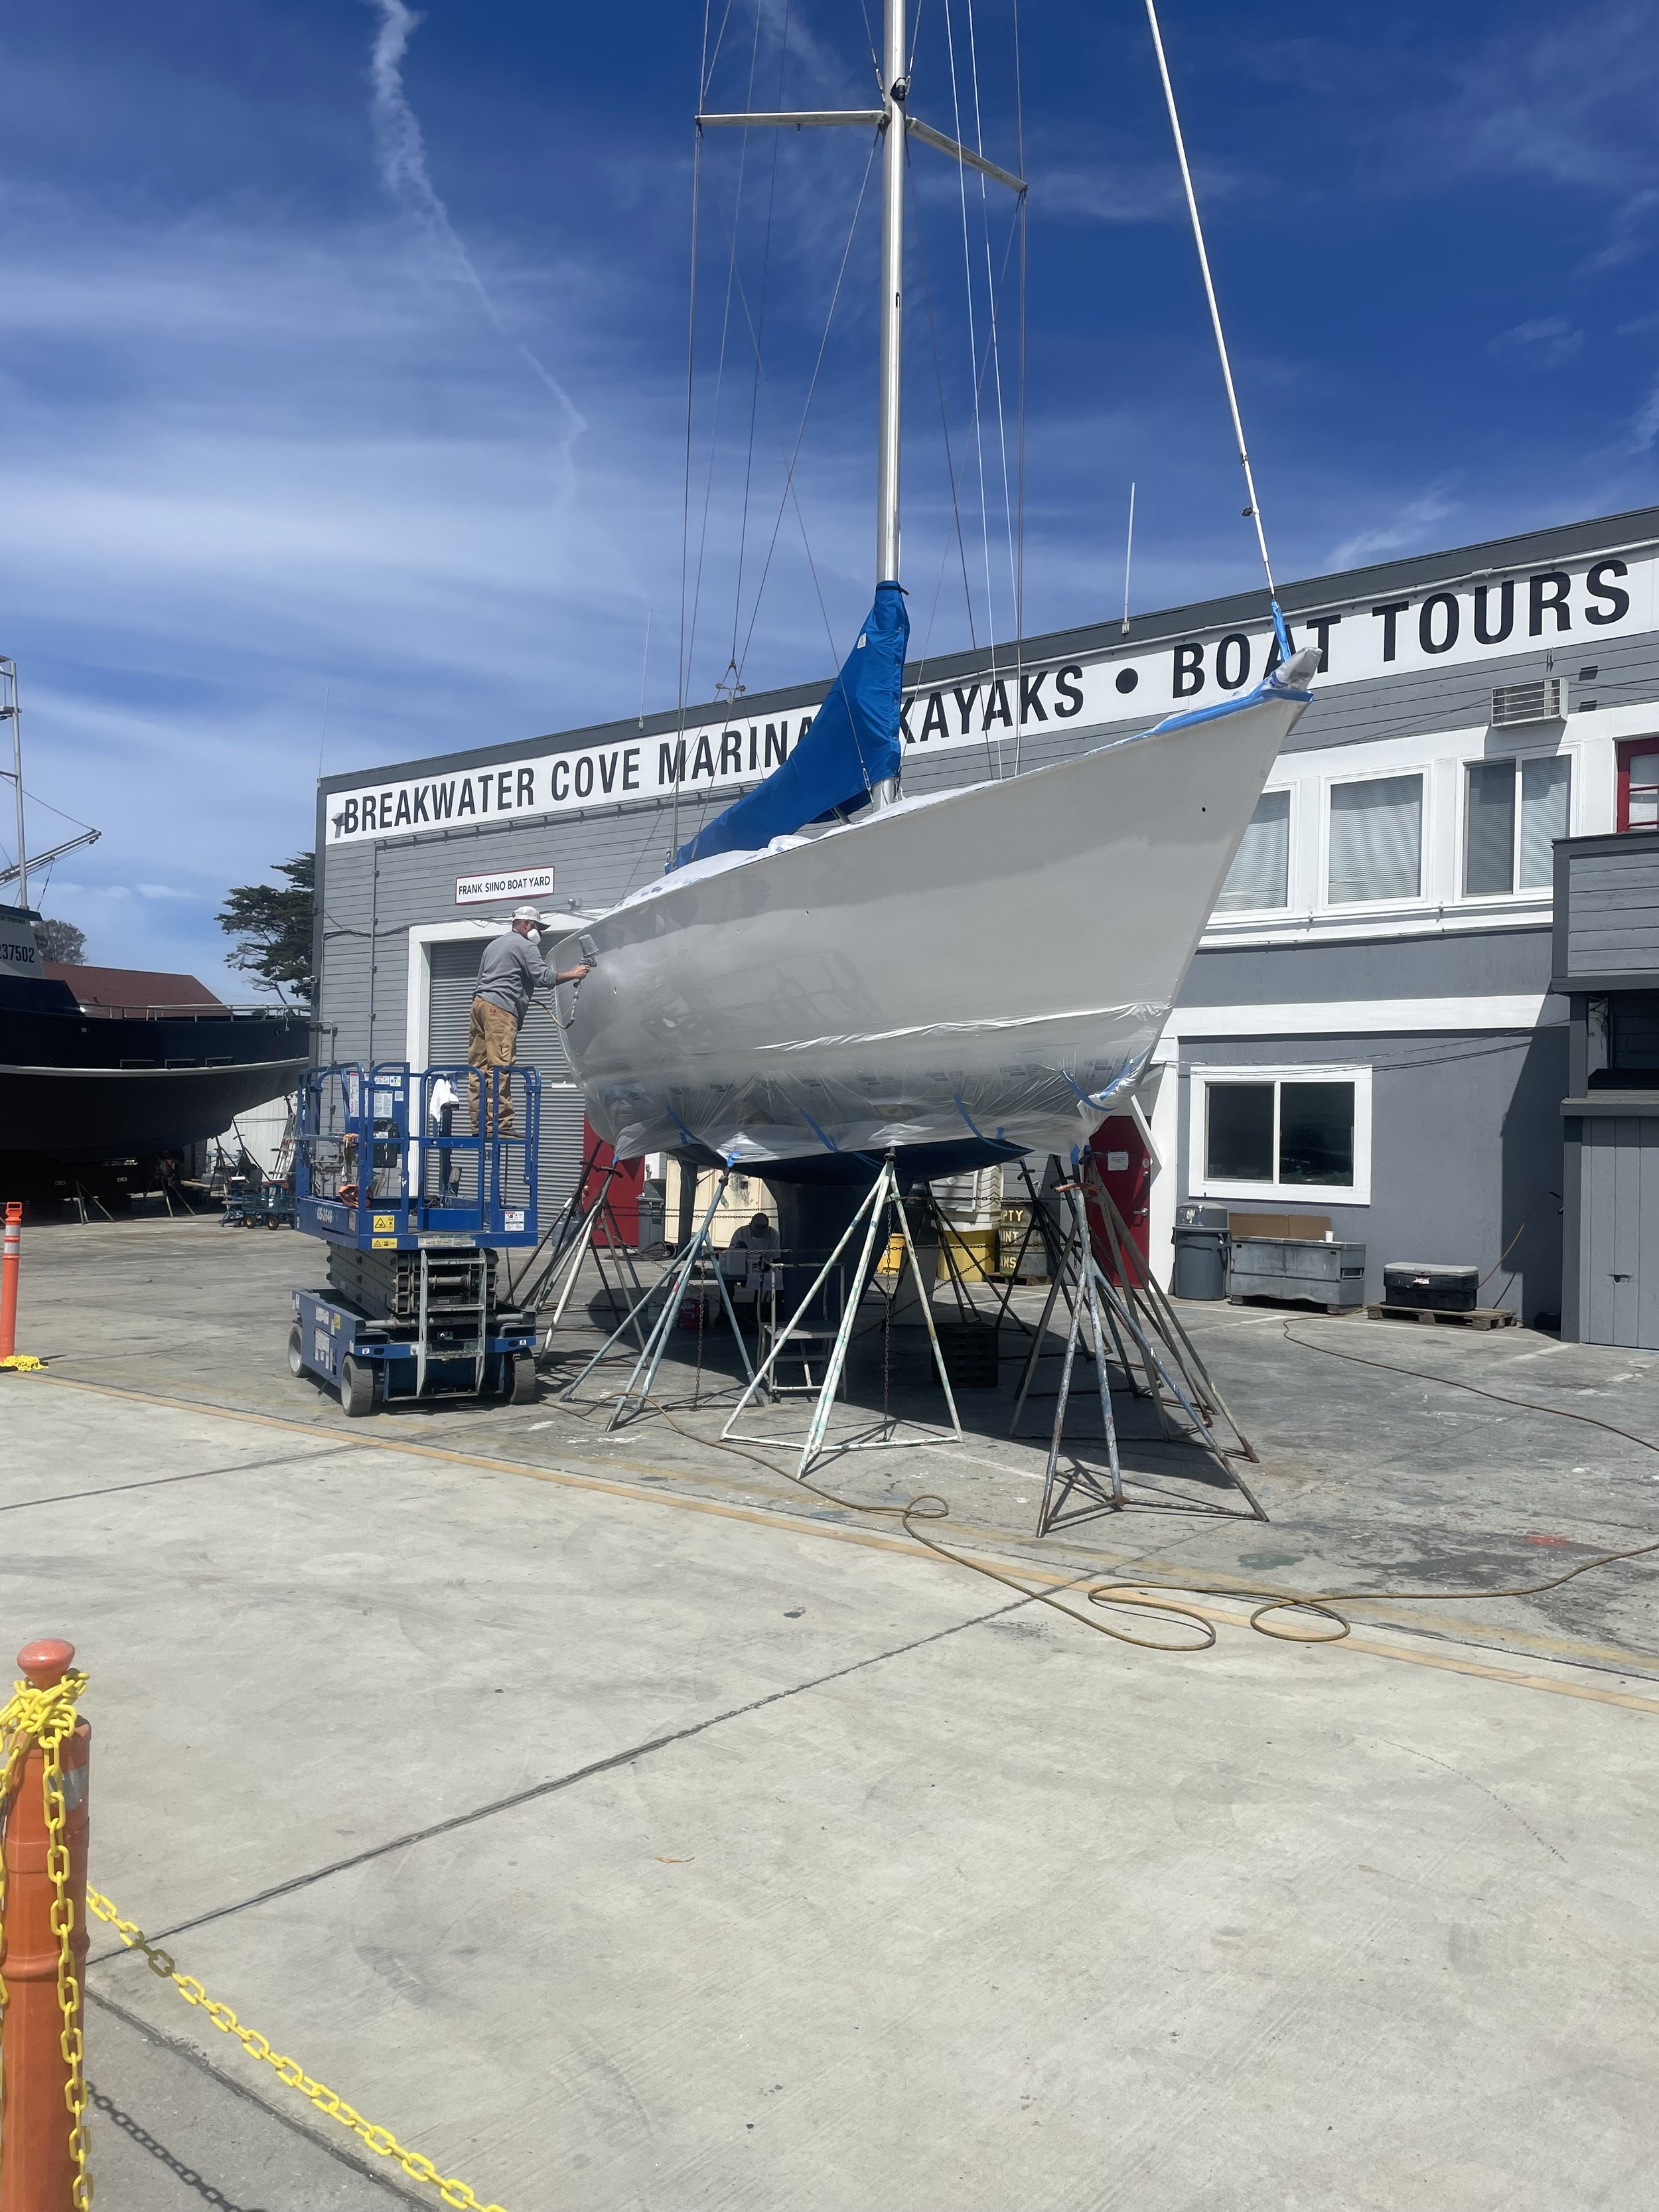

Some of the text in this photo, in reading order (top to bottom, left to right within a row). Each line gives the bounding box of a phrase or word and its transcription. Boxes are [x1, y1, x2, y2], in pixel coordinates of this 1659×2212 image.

[344, 767, 535, 834] BREAKWATER
[551, 747, 640, 801] COVE
[1173, 614, 1342, 700] BOAT
[1372, 559, 1630, 662] TOURS
[459, 875, 551, 895] FRANK SIINO BOAT YARD
[0, 943, 35, 964] 37502
[1001, 1210, 1023, 1222] PTY
[1001, 1230, 1019, 1243] INT
